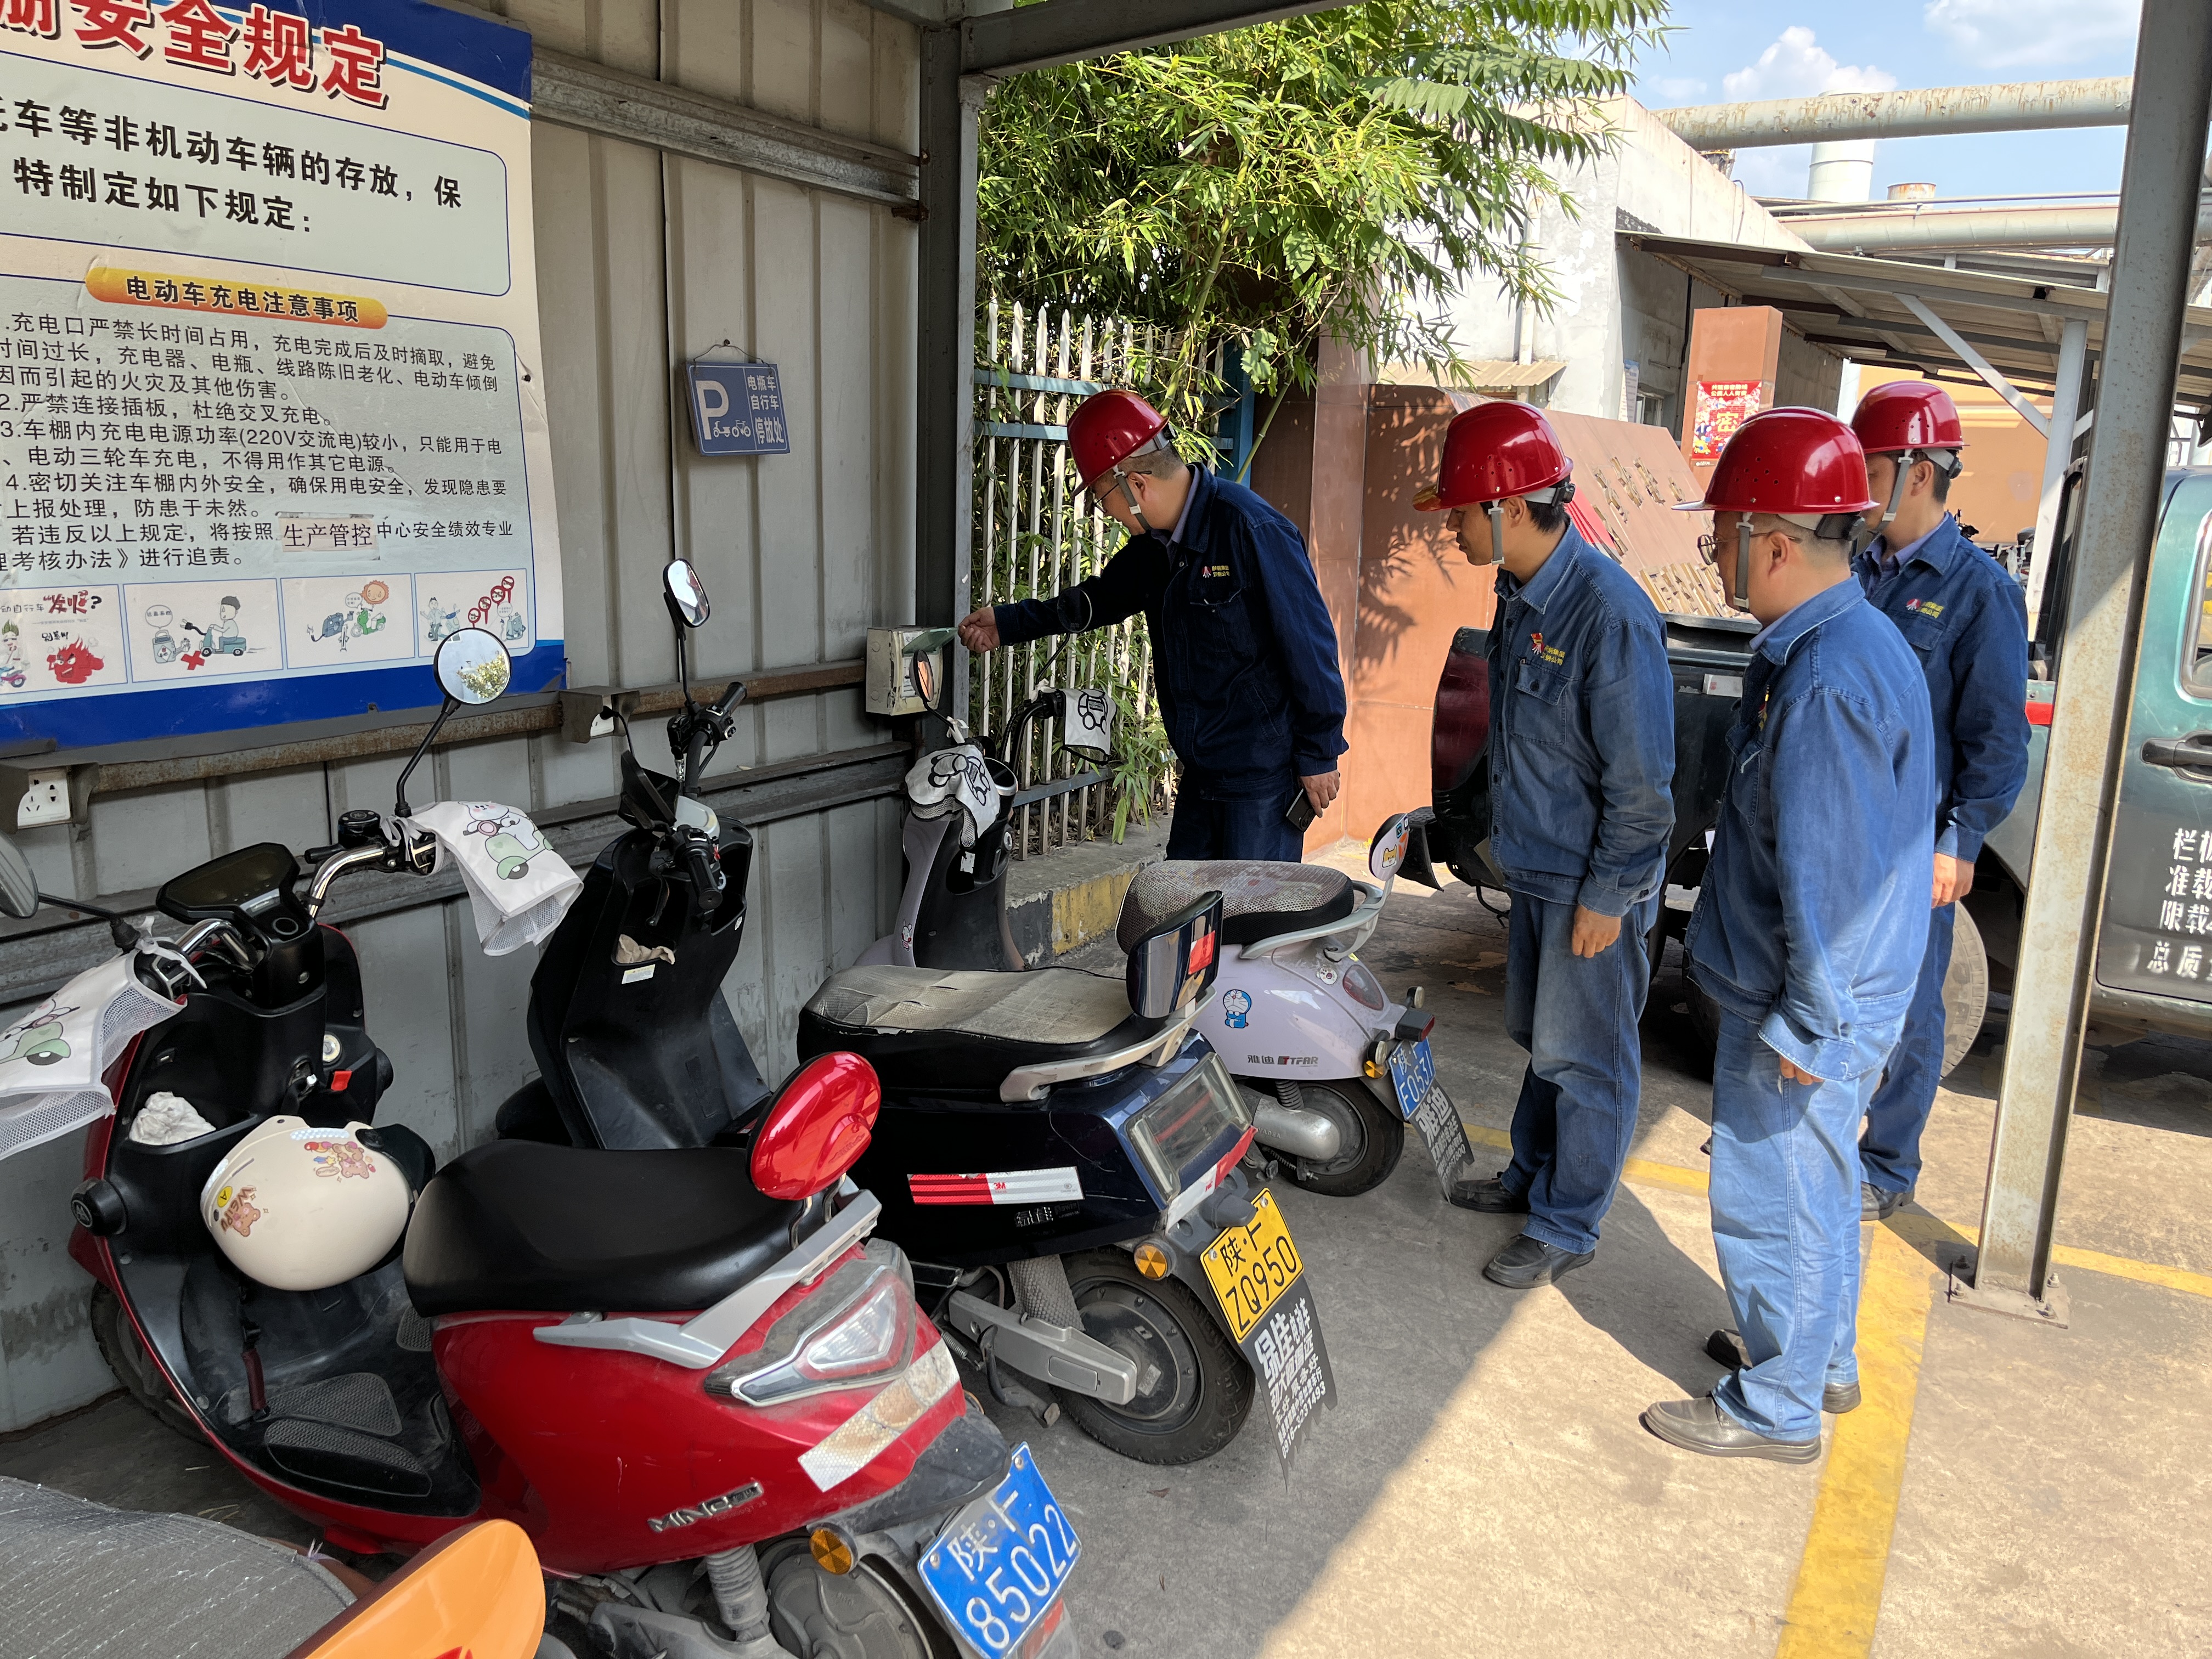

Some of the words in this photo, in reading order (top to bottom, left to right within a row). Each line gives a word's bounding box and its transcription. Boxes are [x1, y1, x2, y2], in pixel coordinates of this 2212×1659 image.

[0, 97, 462, 209] 车等非机动车辆的存放，保
[126, 276, 359, 323] 电动车充电注意事项
[695, 380, 729, 440] P
[747, 375, 777, 391] 电瓶车
[750, 394, 780, 410] 自行车
[754, 416, 785, 444] 停放处
[2147, 939, 2212, 981] 总质
[1400, 1050, 1433, 1114] F0531
[1415, 1086, 1453, 1148] 雅迪
[1226, 1235, 1297, 1333] ZQ950
[966, 1504, 1076, 1649] 85022
